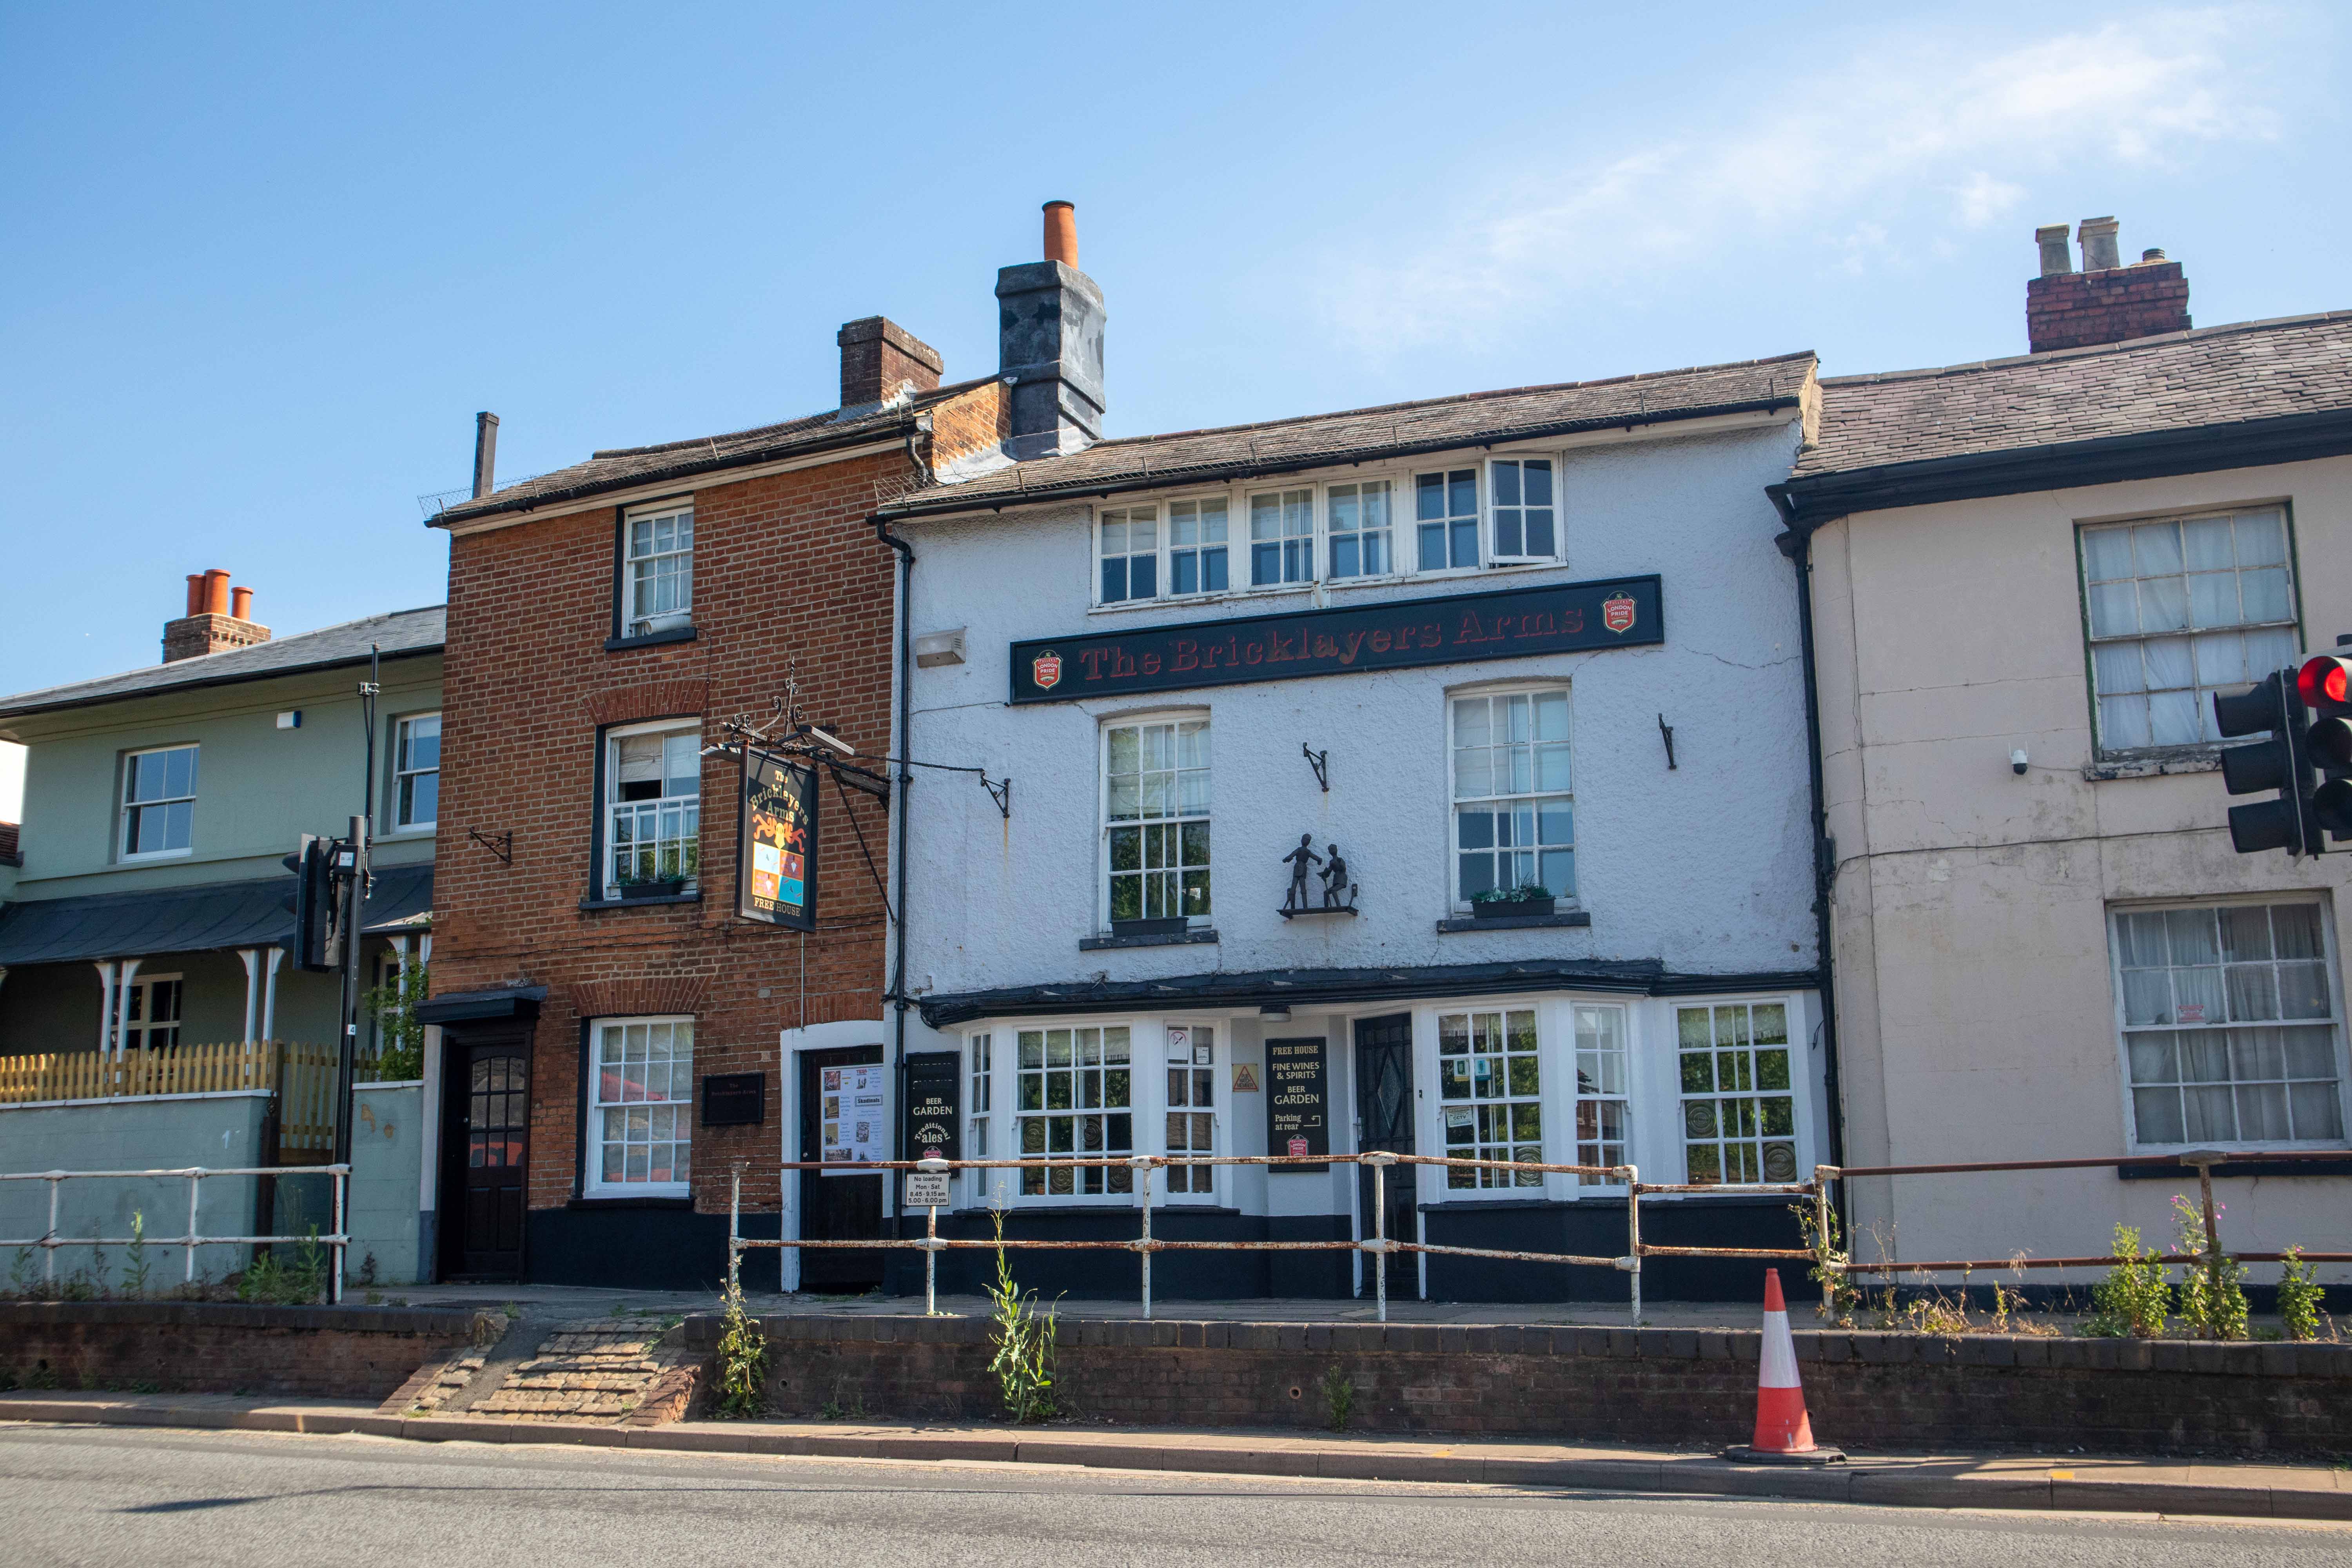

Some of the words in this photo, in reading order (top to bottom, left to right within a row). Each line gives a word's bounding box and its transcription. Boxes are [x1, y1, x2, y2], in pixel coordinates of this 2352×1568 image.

[1079, 645, 1161, 681] The
[1168, 623, 1442, 672] Bricklayers
[1452, 608, 1584, 644] Arms
[775, 770, 788, 784] The
[765, 801, 795, 823] Arms
[754, 897, 774, 911] FREE
[776, 902, 800, 917] HOUSE
[1272, 1047, 1292, 1055] FREE
[1294, 1045, 1318, 1054] HOUSE
[1272, 1063, 1291, 1071] FINE
[1292, 1062, 1320, 1070] WINES
[1286, 1071, 1316, 1079] SPIRITS
[1274, 1094, 1319, 1104] GARDEN
[913, 1106, 953, 1115] GARDEN
[1275, 1114, 1302, 1123] Parking
[914, 1122, 951, 1140] Traditional
[922, 1132, 943, 1143] ales
